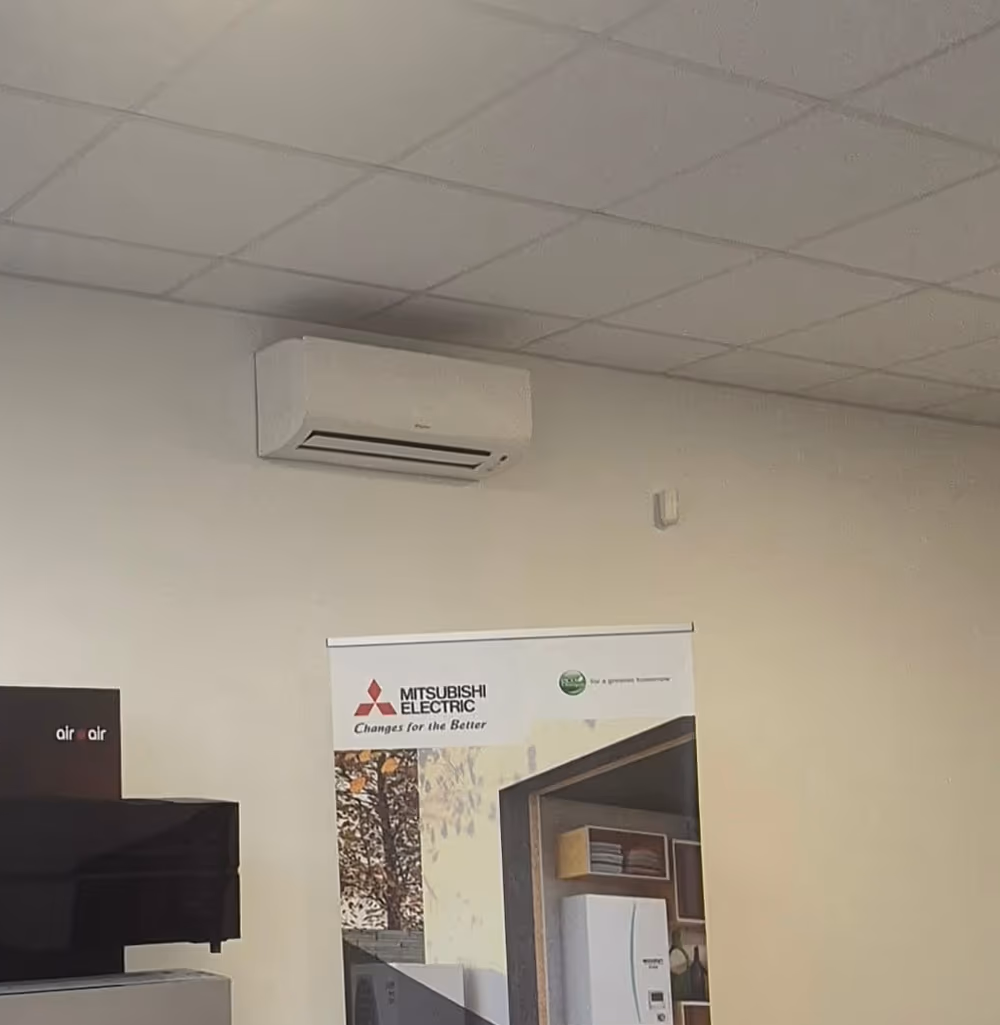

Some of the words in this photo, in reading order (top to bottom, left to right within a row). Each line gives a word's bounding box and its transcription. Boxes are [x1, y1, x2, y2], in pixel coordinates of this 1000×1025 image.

[400, 684, 487, 701] MITSUBISHI
[401, 699, 476, 715] ELECTRIC
[56, 725, 75, 741] air
[88, 725, 107, 741] air
[353, 722, 403, 735] Changes
[406, 722, 425, 733] for
[428, 721, 446, 732] the
[450, 719, 487, 731] Better
